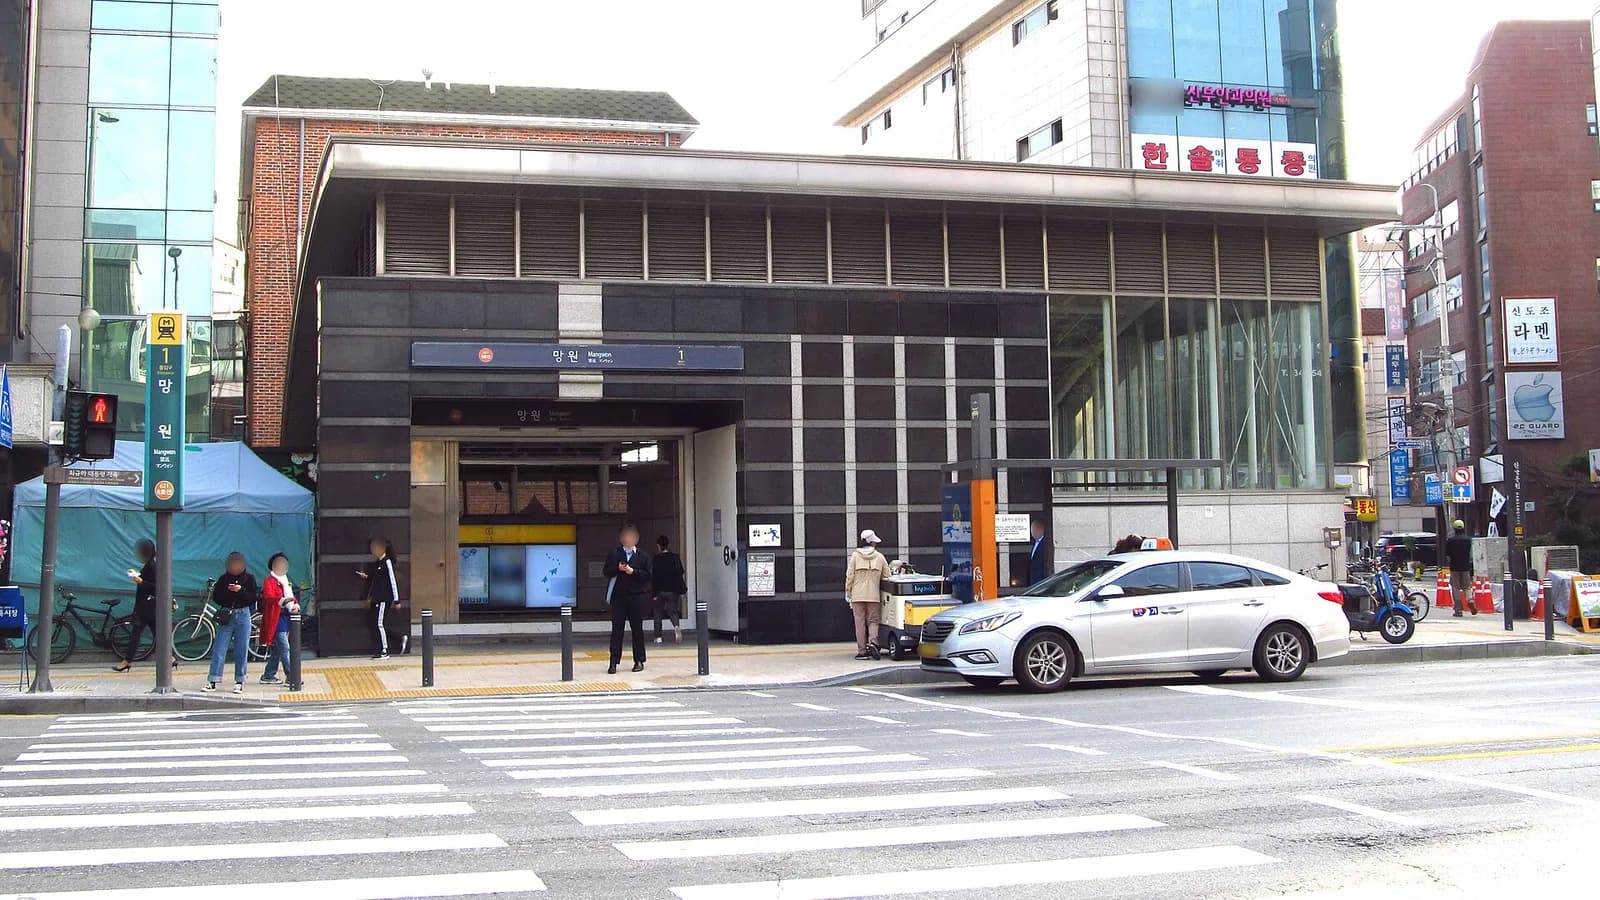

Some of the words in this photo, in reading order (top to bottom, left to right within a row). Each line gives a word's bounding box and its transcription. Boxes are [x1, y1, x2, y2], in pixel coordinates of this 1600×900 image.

[1142, 142, 1214, 172] 한솔
[1512, 306, 1550, 316] 신도조
[1513, 322, 1550, 340] 라멘
[162, 347, 169, 364] 1
[552, 350, 578, 363] 망원
[679, 350, 684, 361] 1
[517, 409, 541, 422] 망원
[1355, 500, 1376, 514] 동산
